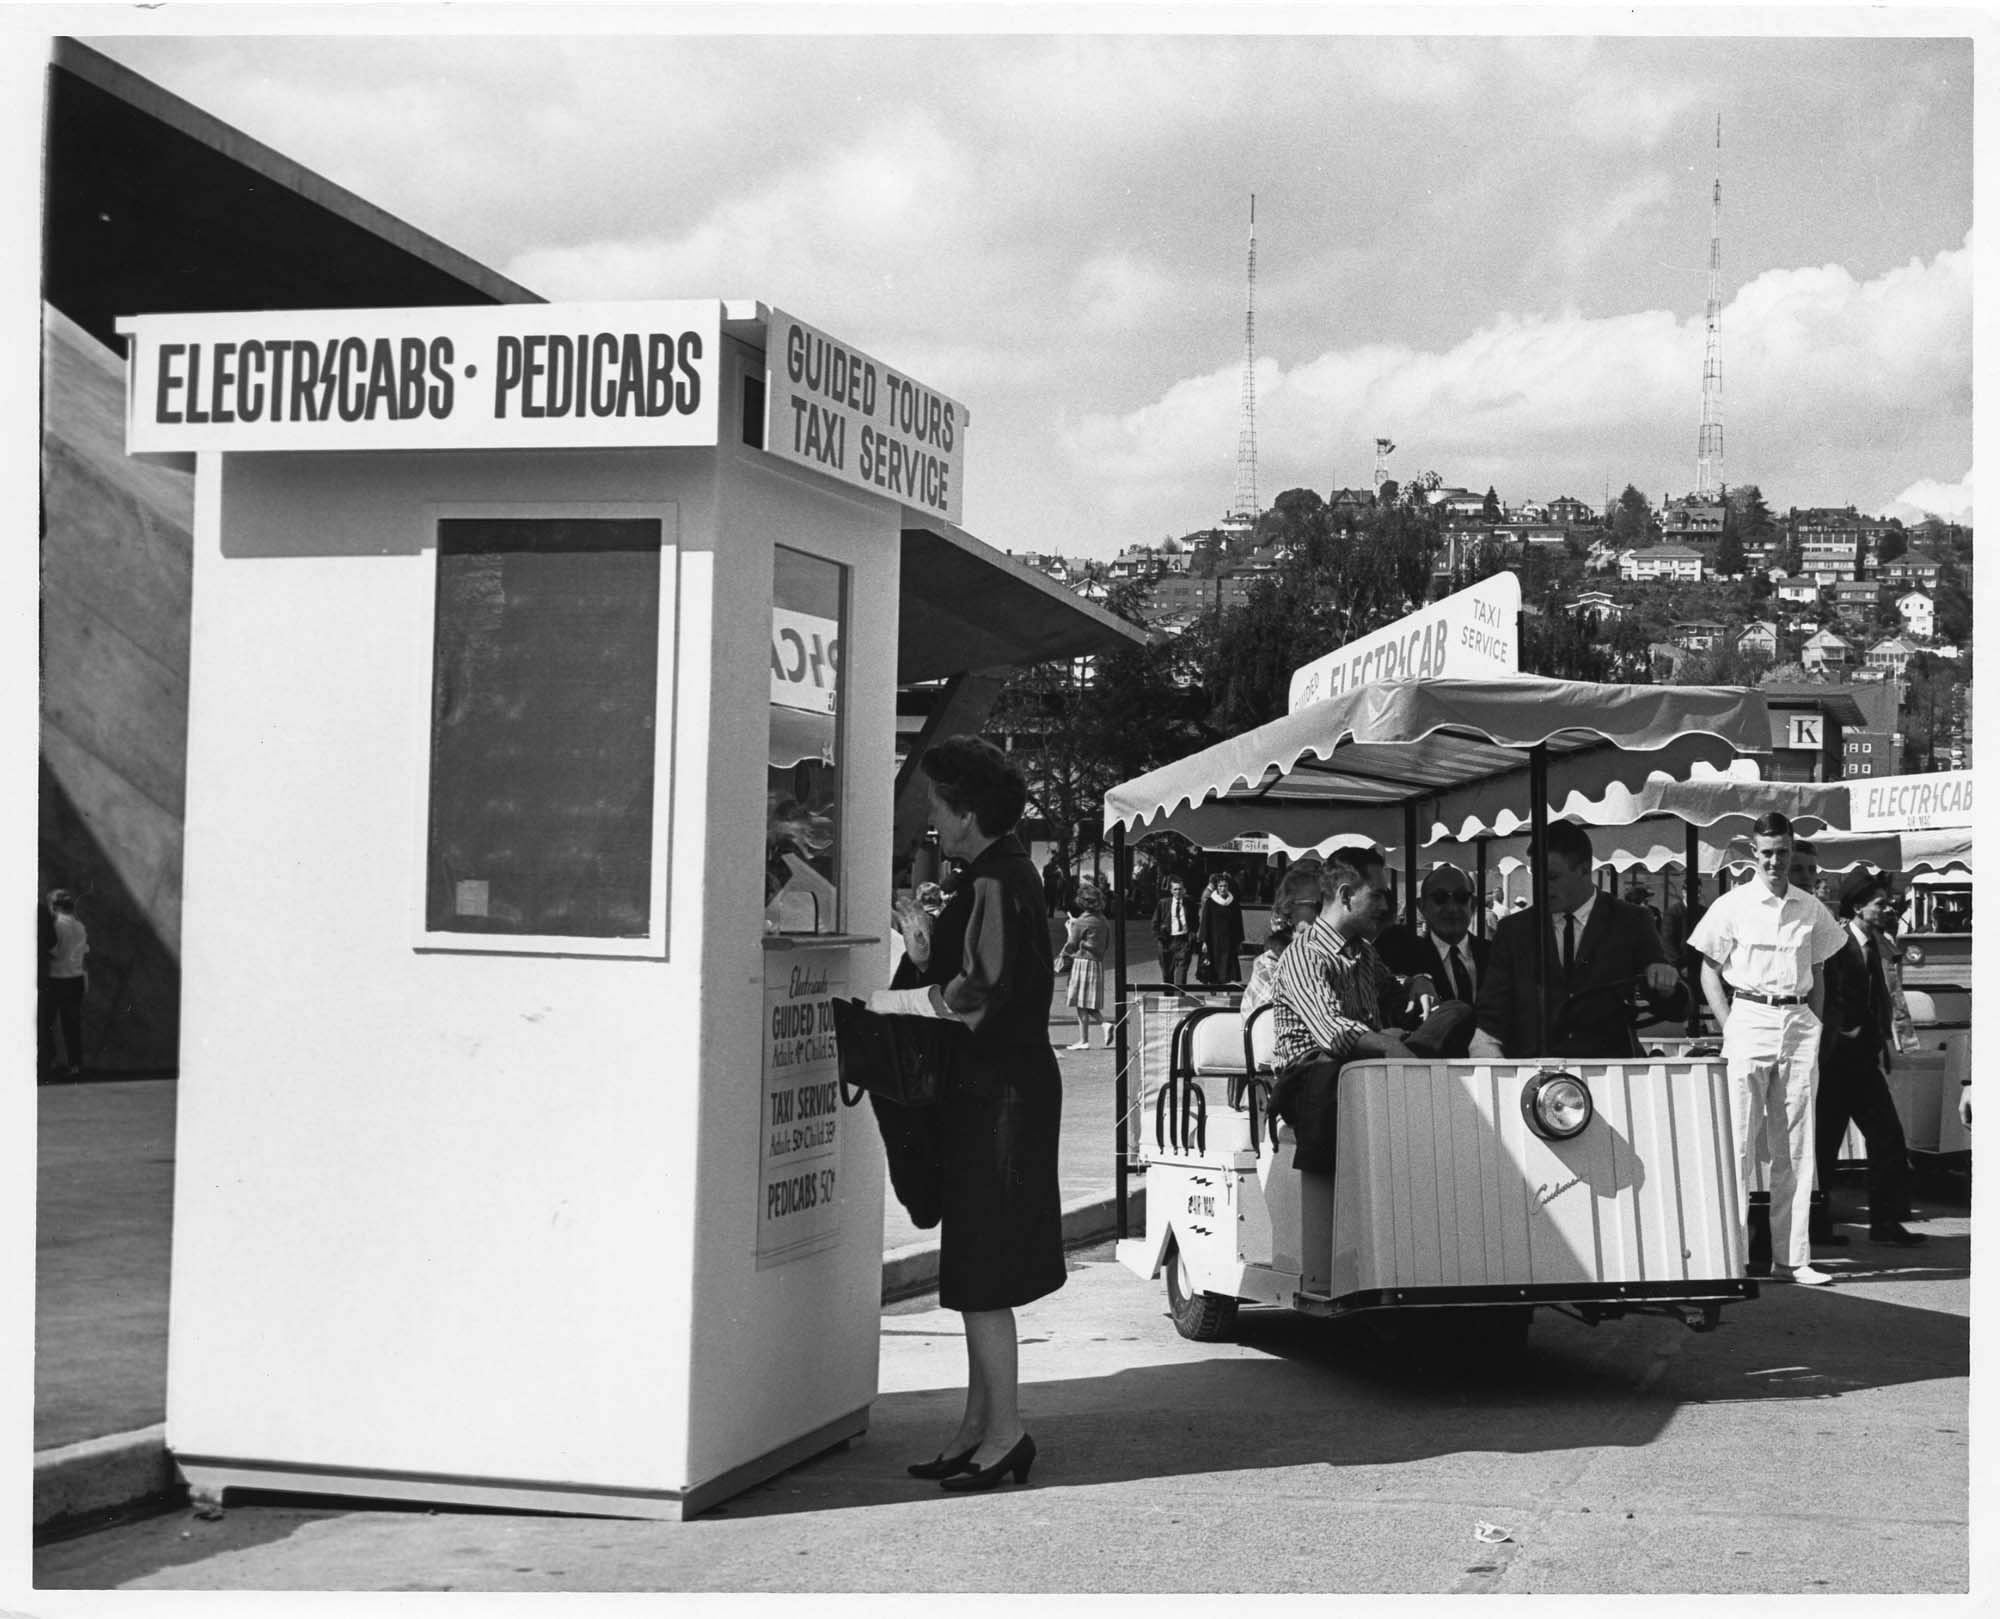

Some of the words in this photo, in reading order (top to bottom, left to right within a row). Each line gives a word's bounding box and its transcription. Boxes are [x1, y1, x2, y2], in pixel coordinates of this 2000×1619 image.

[494, 330, 703, 419] PEDICABS
[787, 324, 877, 417] GUIDED
[886, 373, 954, 453] TOURS
[791, 394, 846, 470] TAXI
[859, 424, 949, 511] SERVICE
[1473, 598, 1502, 629] TAXI
[1460, 625, 1508, 663] SERVICE
[1793, 719, 1819, 743] K
[772, 1004, 815, 1041] GUIDED
[771, 1088, 794, 1126] TAXI
[798, 1080, 838, 1120] SERVICE
[767, 1171, 817, 1220] PEDICABS
